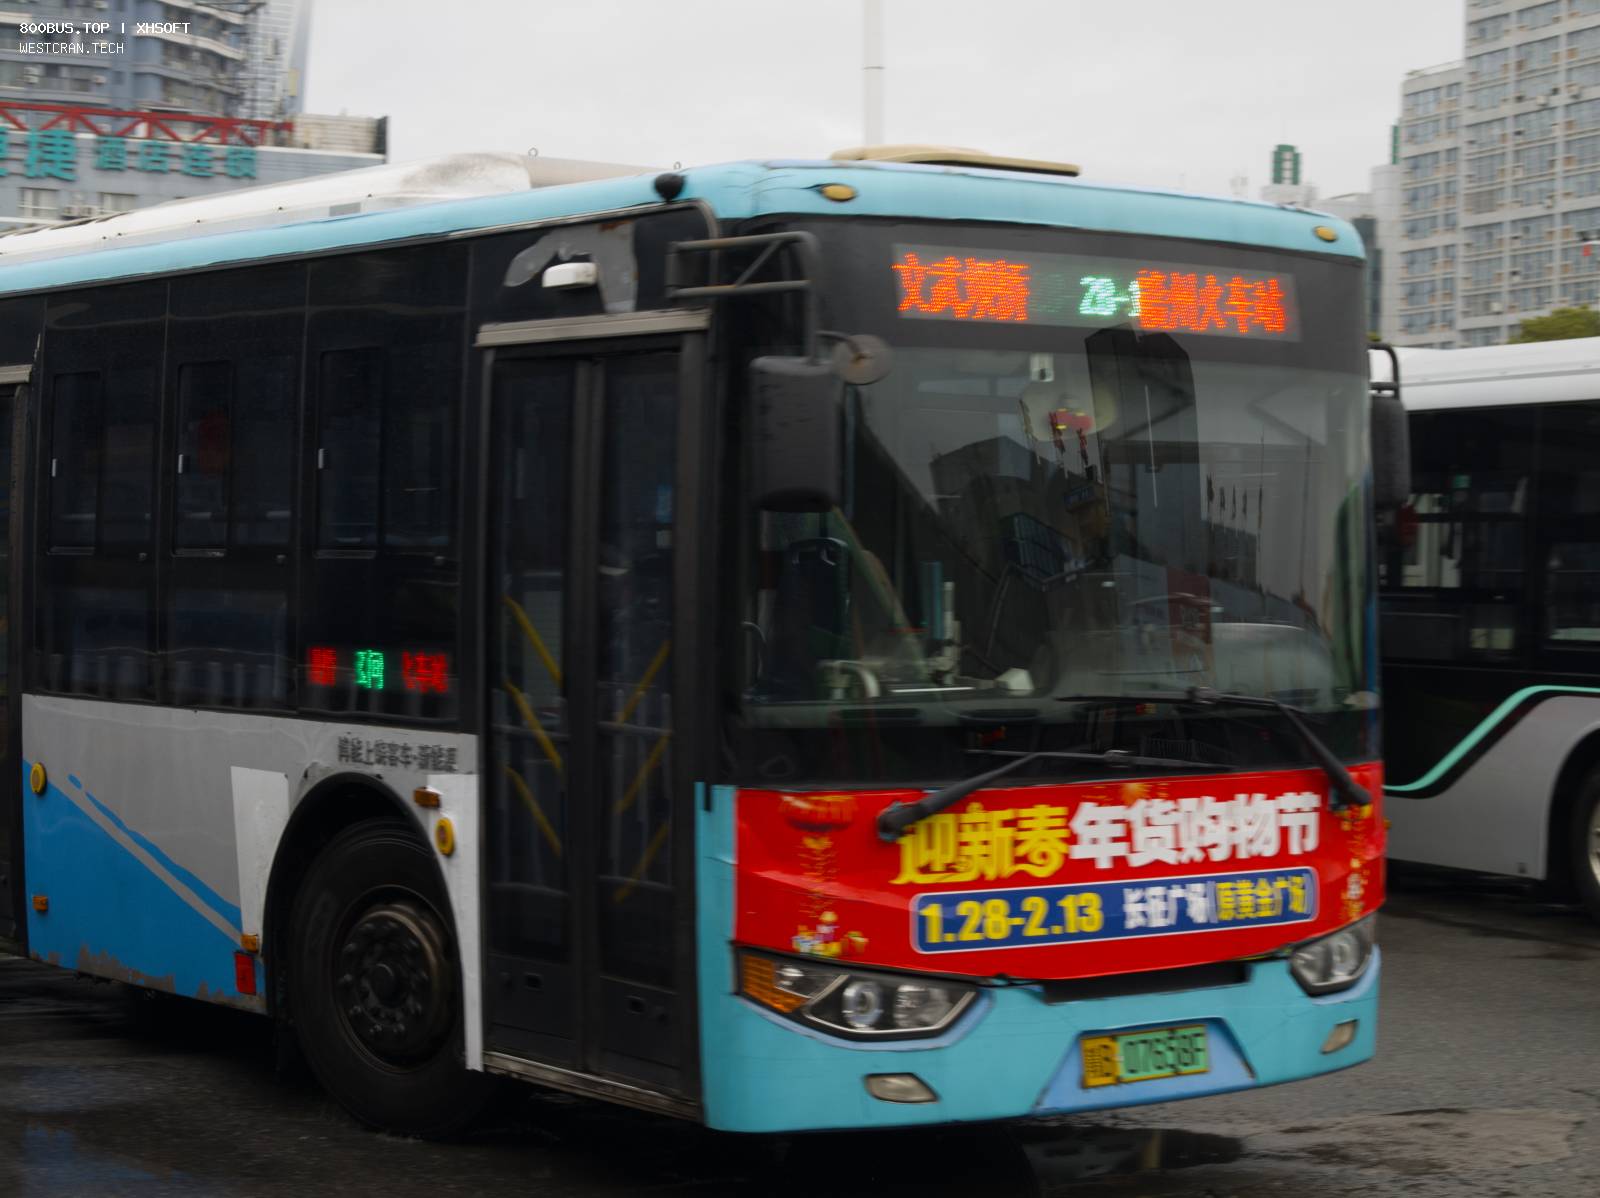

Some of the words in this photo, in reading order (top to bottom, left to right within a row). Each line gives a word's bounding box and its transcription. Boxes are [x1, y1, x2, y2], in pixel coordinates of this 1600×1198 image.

[0, 125, 77, 181] 捷
[889, 791, 1321, 886] 迎新春年货购物节
[918, 893, 1104, 944] 1.28-2.13
